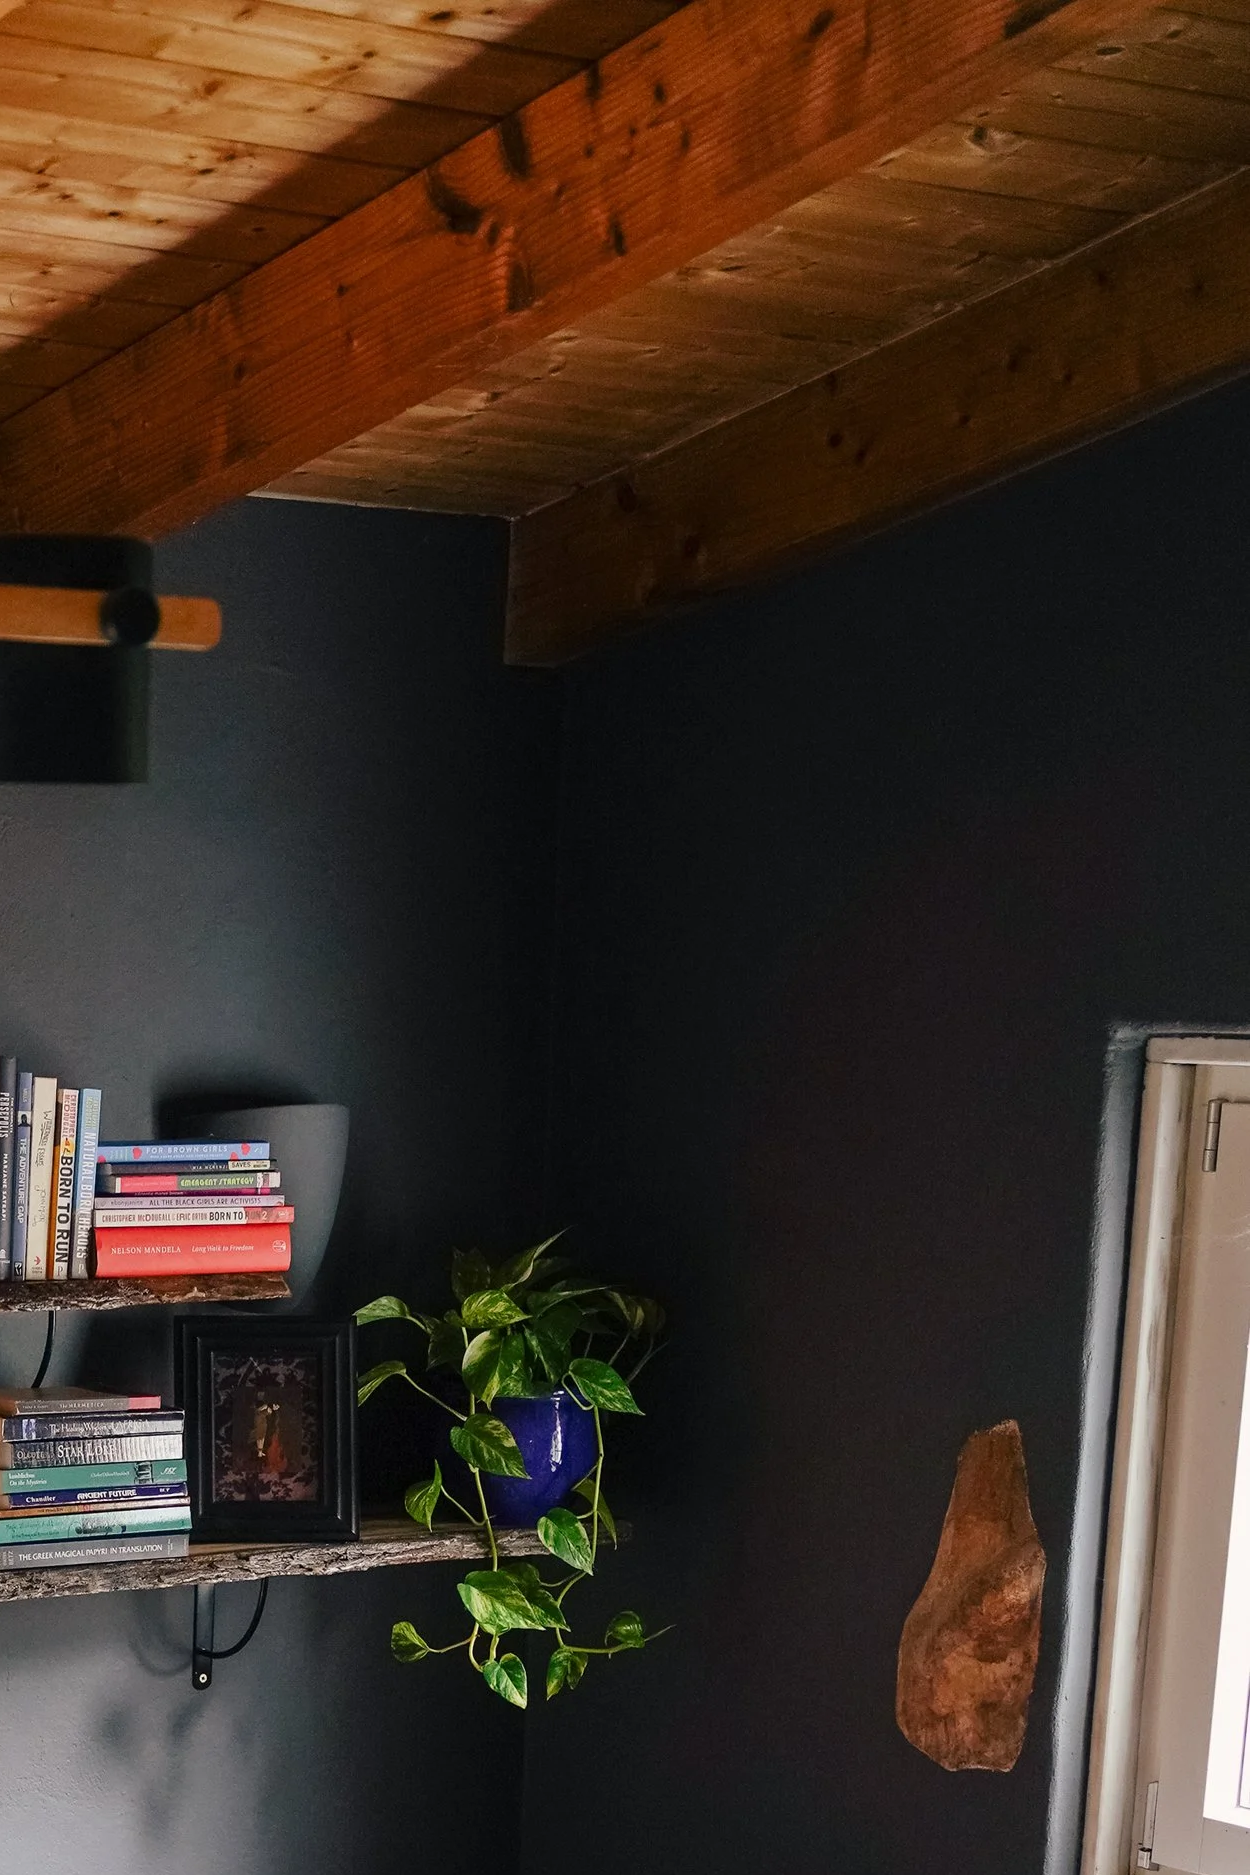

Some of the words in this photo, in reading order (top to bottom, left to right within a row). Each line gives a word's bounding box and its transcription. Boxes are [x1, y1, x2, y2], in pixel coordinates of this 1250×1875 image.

[19, 1138, 27, 1154] THE
[168, 1146, 198, 1154] BROWN
[82, 1132, 96, 1182] NATURAL
[18, 1156, 26, 1204] ADVENTURE
[60, 1156, 72, 1198] BORN
[180, 1178, 218, 1187] EMERGENT
[218, 1177, 254, 1186] STRATEGY
[79, 1184, 92, 1214] BORN
[162, 1198, 174, 1206] THE
[16, 1206, 25, 1224] GAP
[58, 1201, 70, 1224] TO
[102, 1214, 136, 1222] CHRISTOPHER
[176, 1212, 191, 1221] ERIC
[192, 1212, 208, 1220] ORTON
[209, 1212, 232, 1221] BORN
[232, 1212, 244, 1220] TO
[262, 1211, 268, 1220] 2
[56, 1228, 68, 1263] RUN
[76, 1217, 90, 1258] HEROES
[111, 1246, 142, 1254] NELSON
[144, 1246, 182, 1254] MANDELA
[192, 1245, 207, 1253] Long
[208, 1244, 222, 1252] Walk
[228, 1244, 254, 1252] Freedom
[26, 1496, 56, 1504] Chandler
[76, 1490, 108, 1500] ANCIENT
[108, 1488, 137, 1498] FUTURE
[18, 1554, 32, 1562] THE
[34, 1552, 54, 1560] GREEK
[54, 1550, 84, 1560] MAGICAL
[86, 1548, 108, 1558] PAPYRI
[118, 1544, 162, 1554] TRANSLATION
